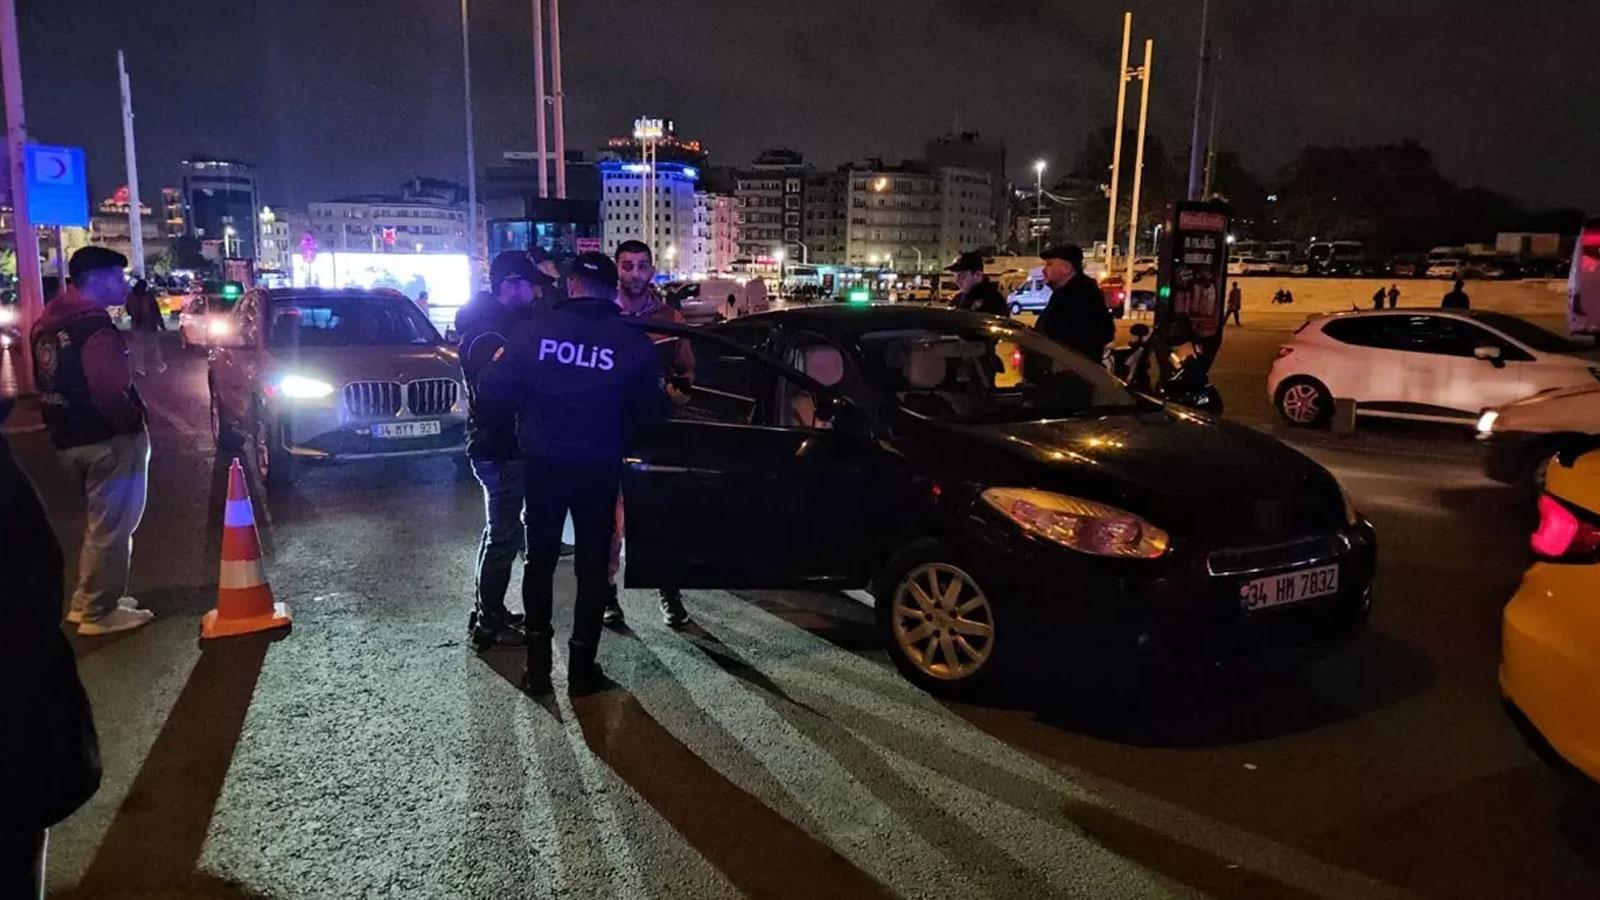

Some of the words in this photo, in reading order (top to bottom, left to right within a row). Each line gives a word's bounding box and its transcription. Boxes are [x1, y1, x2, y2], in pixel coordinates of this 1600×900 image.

[379, 424, 391, 437] 34
[420, 422, 438, 433] 921
[1248, 583, 1267, 606] 34
[1276, 577, 1295, 602] HM
[1300, 569, 1336, 597] 7832
